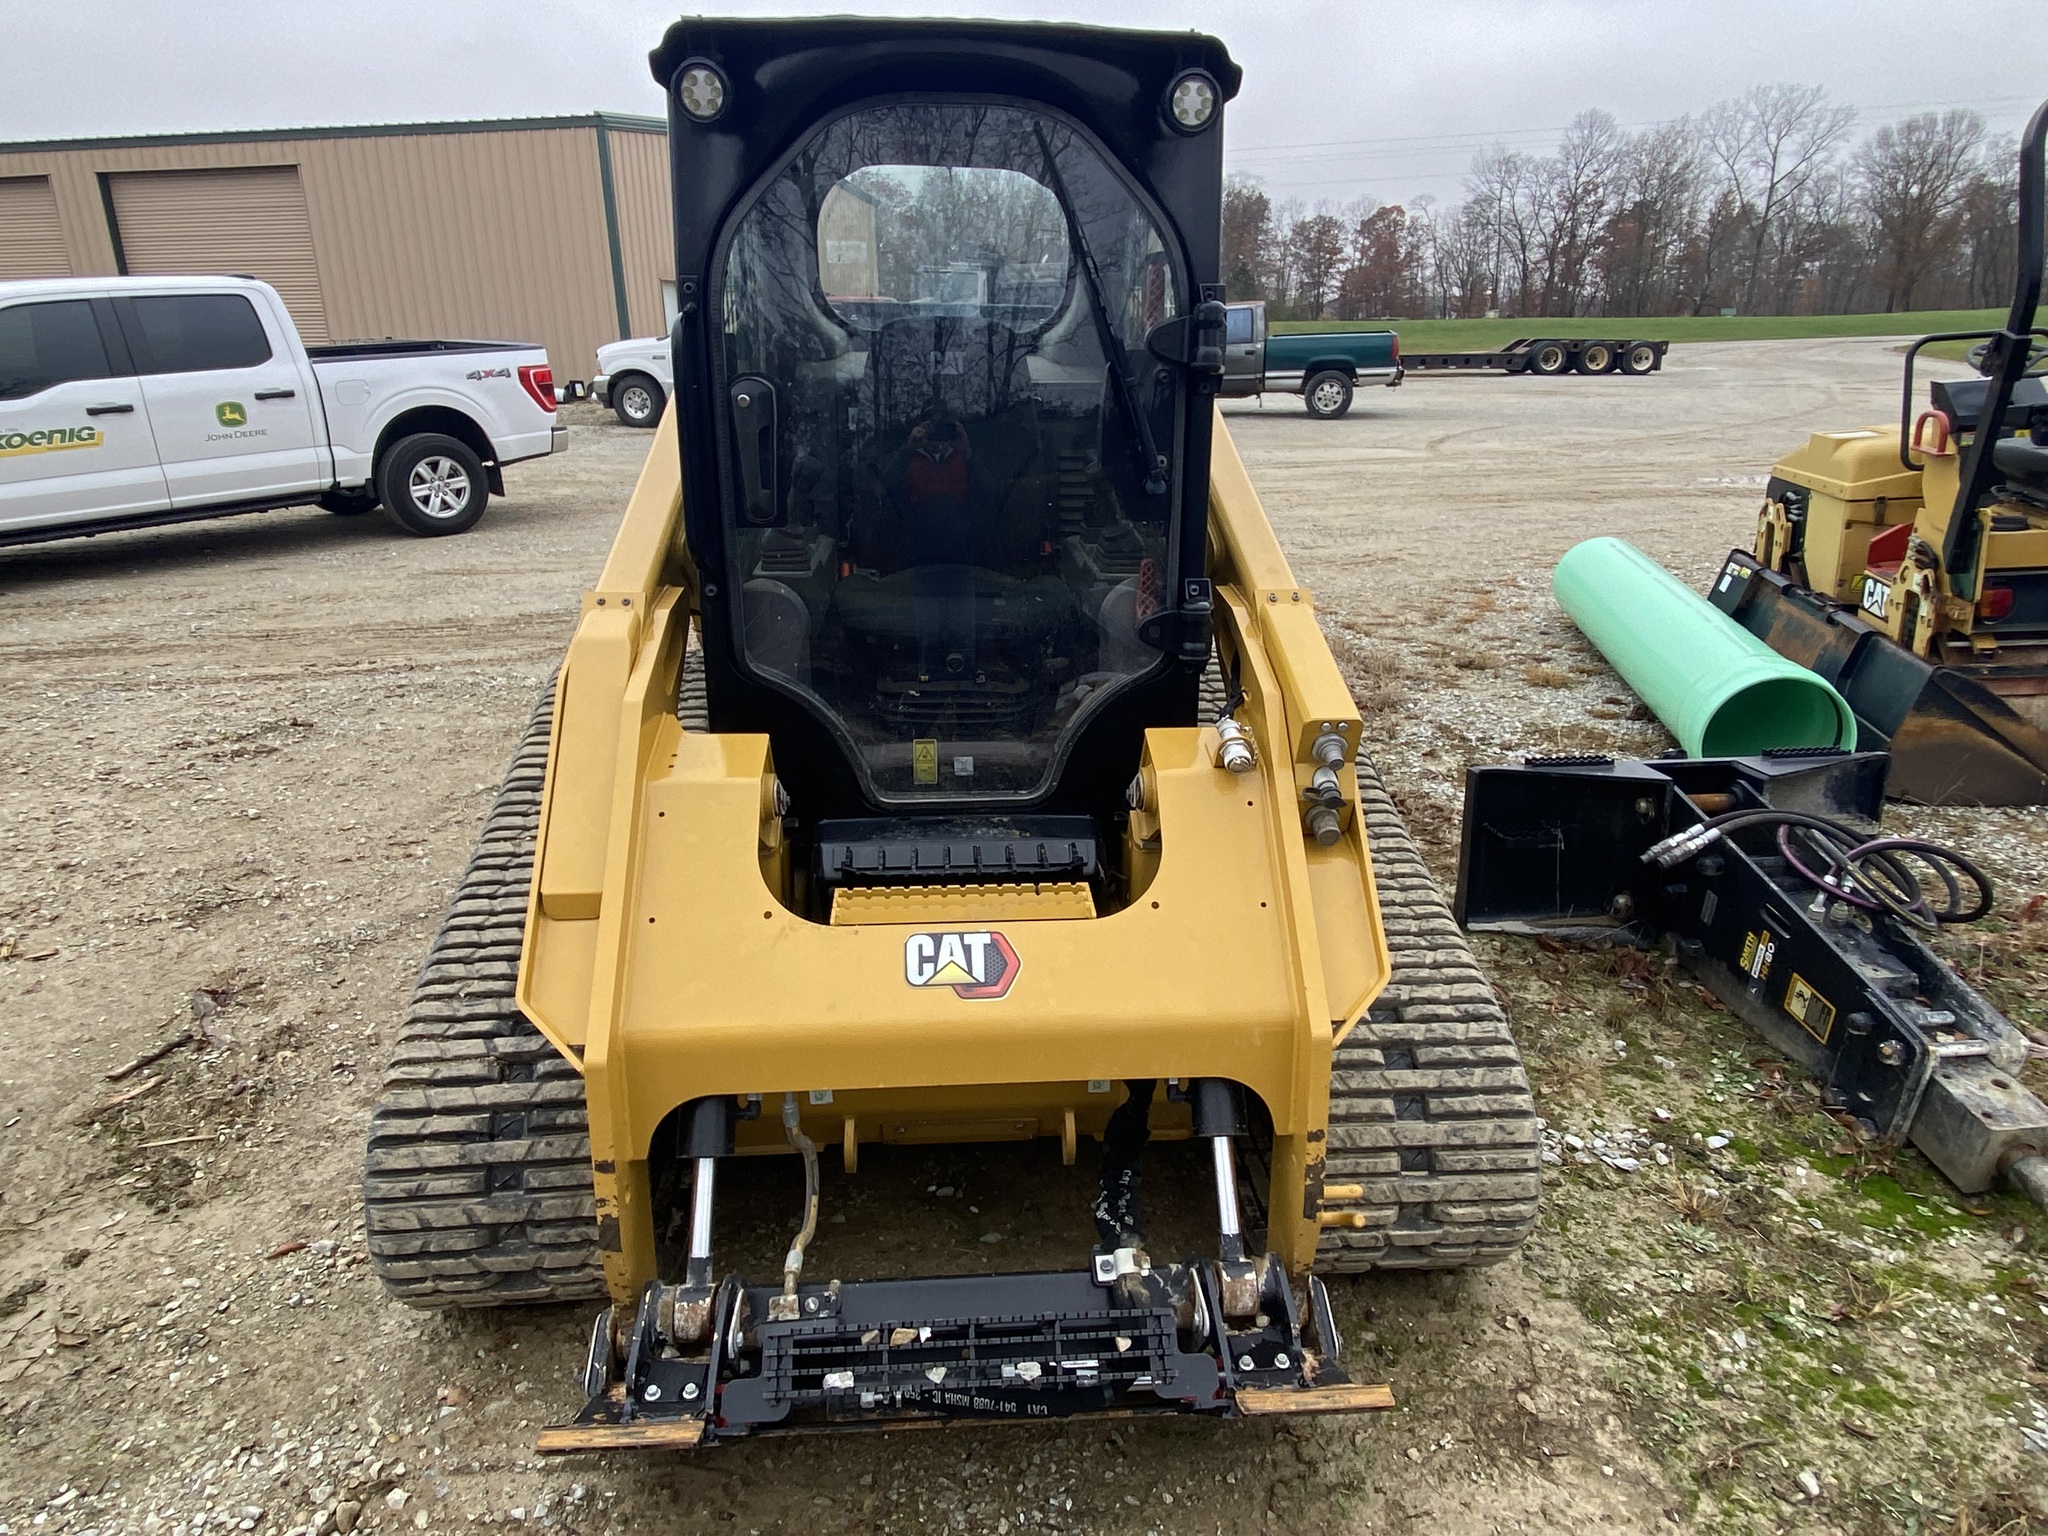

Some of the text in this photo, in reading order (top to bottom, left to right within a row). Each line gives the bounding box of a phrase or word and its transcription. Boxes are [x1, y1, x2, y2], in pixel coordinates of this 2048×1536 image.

[930, 351, 967, 375] CAT
[204, 429, 269, 442] JOHN DEERE
[906, 932, 992, 986] CAT
[1740, 931, 1758, 971] SMITH
[945, 1392, 970, 1407] MSHA
